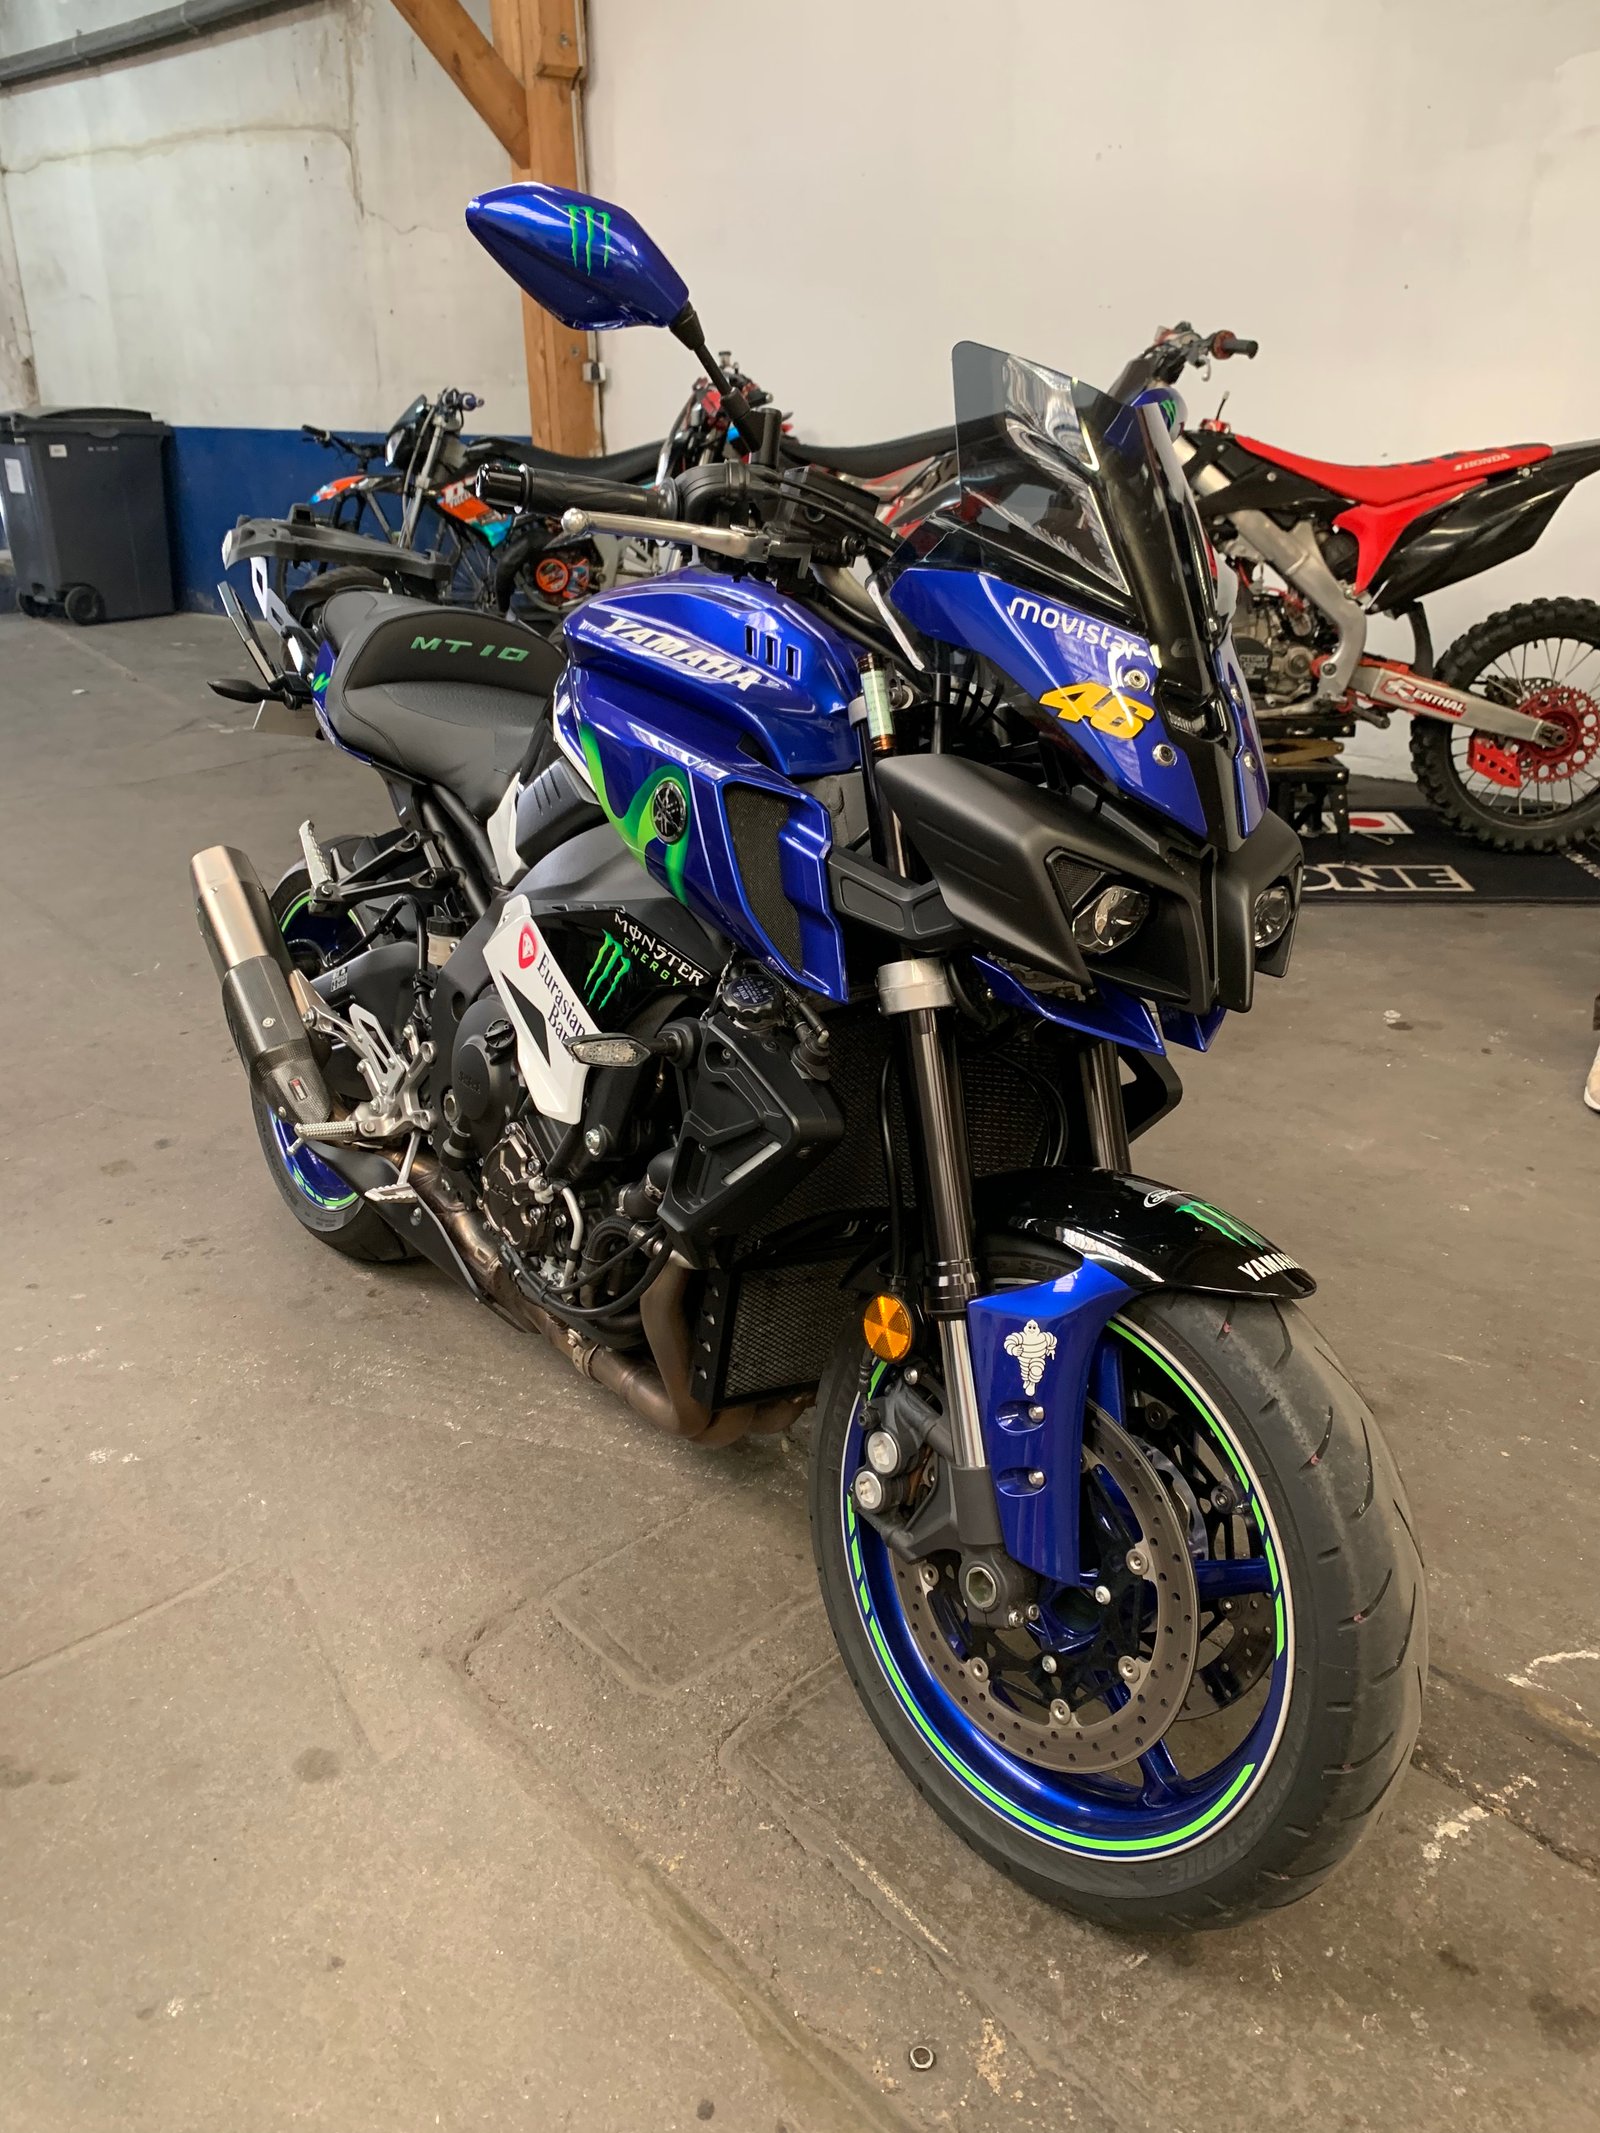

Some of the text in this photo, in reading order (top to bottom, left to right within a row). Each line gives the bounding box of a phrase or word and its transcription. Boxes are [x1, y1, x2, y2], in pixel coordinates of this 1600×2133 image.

[1463, 453, 1511, 469] HONDA
[410, 636, 530, 662] MT 10
[604, 614, 762, 692] YAMAHA
[1010, 597, 1144, 660] movistar
[1039, 681, 1156, 740] 46
[614, 912, 704, 987] MONSTER
[623, 937, 681, 986] ENERGY
[537, 952, 586, 1037] Eurasian
[1237, 1253, 1302, 1282] YAMAH
